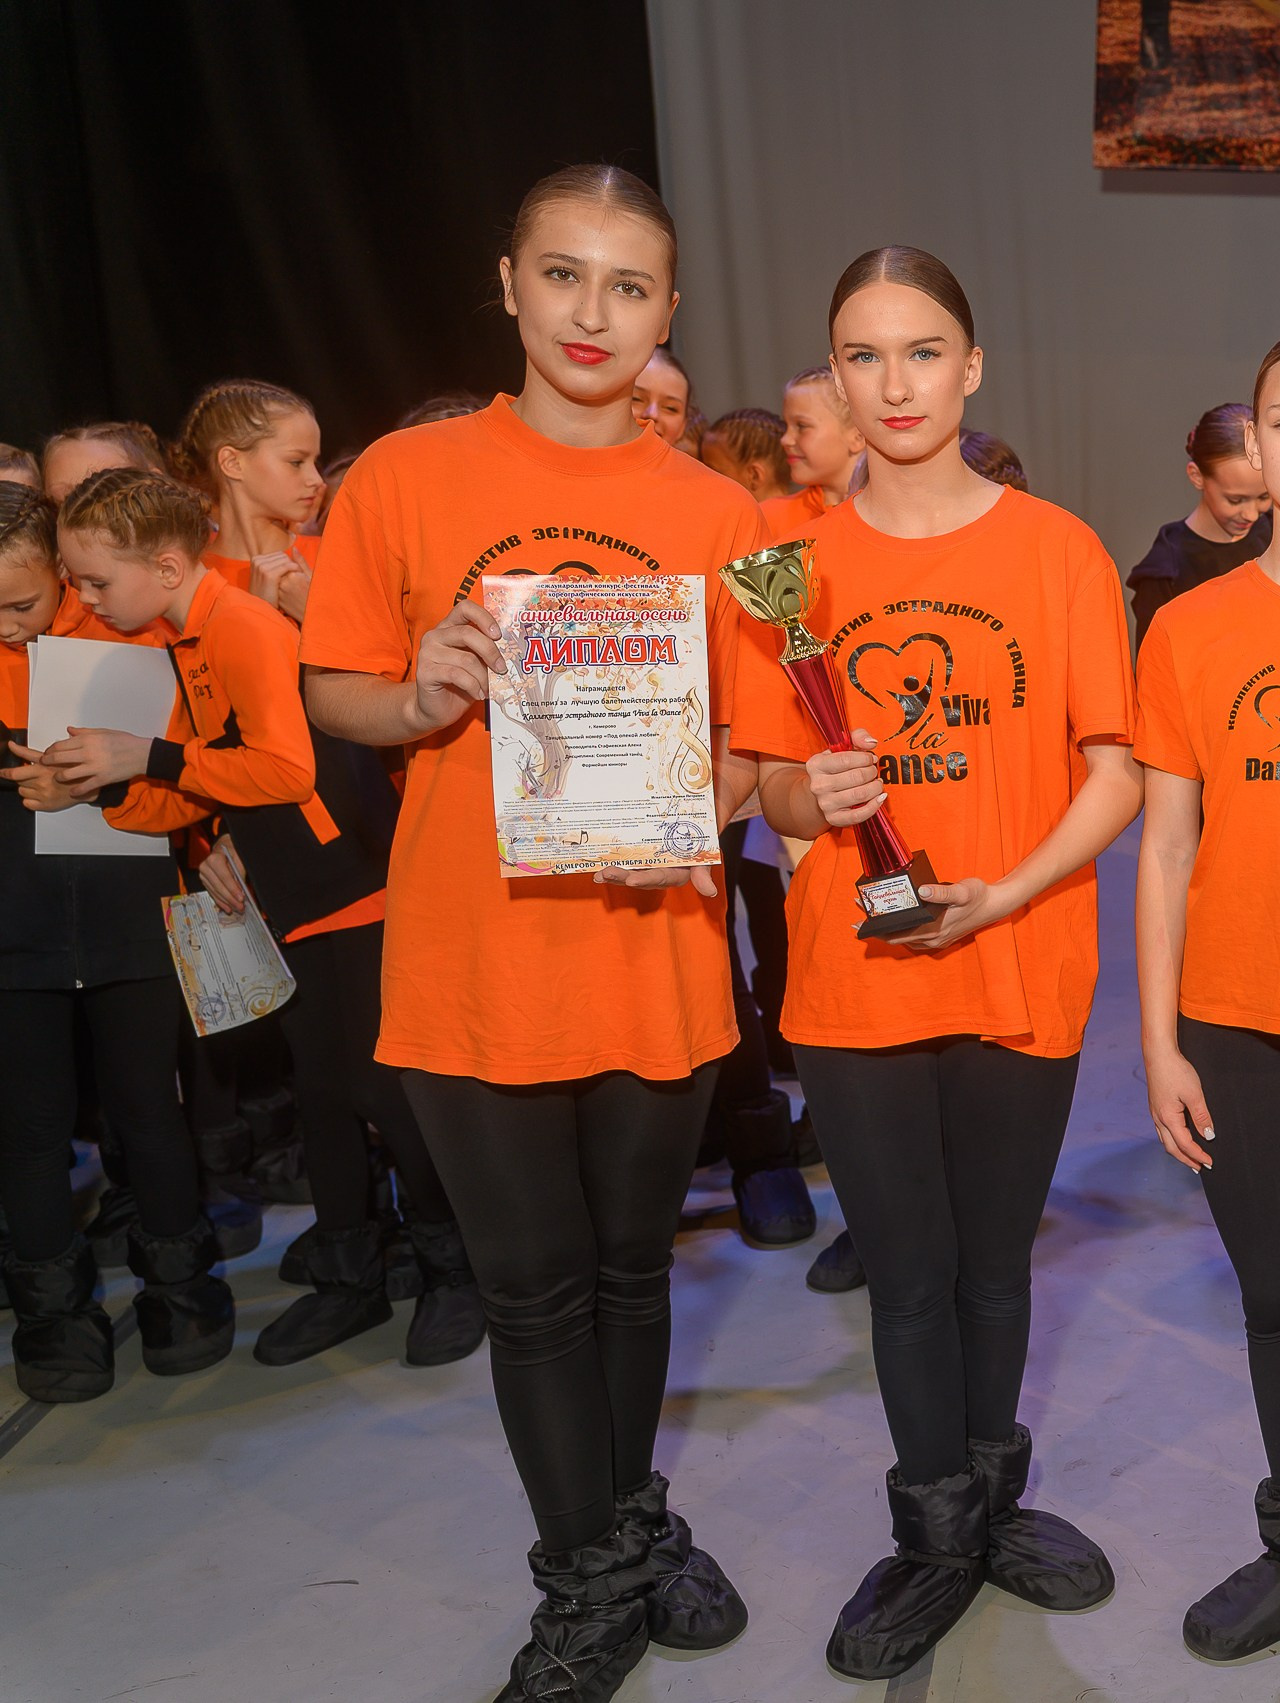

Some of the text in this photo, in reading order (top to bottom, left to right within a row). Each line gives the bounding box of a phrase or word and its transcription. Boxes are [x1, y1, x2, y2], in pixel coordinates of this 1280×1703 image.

[453, 526, 661, 606] ЛЛЕКТИВ ЭСТРАДНОГО
[512, 604, 688, 624] Танцевальная осень
[521, 635, 679, 674] ДИПЛОМ
[882, 599, 1004, 632] ЭСТРАДНОГО
[1005, 638, 1026, 709] ТАНЦА
[521, 700, 540, 708] Спец
[540, 700, 558, 708] приз
[570, 698, 600, 706] лучшую
[601, 696, 668, 705] балетмейстерскую
[669, 696, 693, 704] работу
[576, 685, 626, 693] Награждается
[1228, 664, 1276, 730] КОЛЛЕКТИВ
[632, 709, 650, 717] Viva
[659, 708, 682, 717] Dance
[906, 713, 949, 750] la
[866, 750, 968, 785] ance
[555, 861, 596, 870] КЕМЕРОВО
[610, 859, 643, 867] ОКТЯБРЯ
